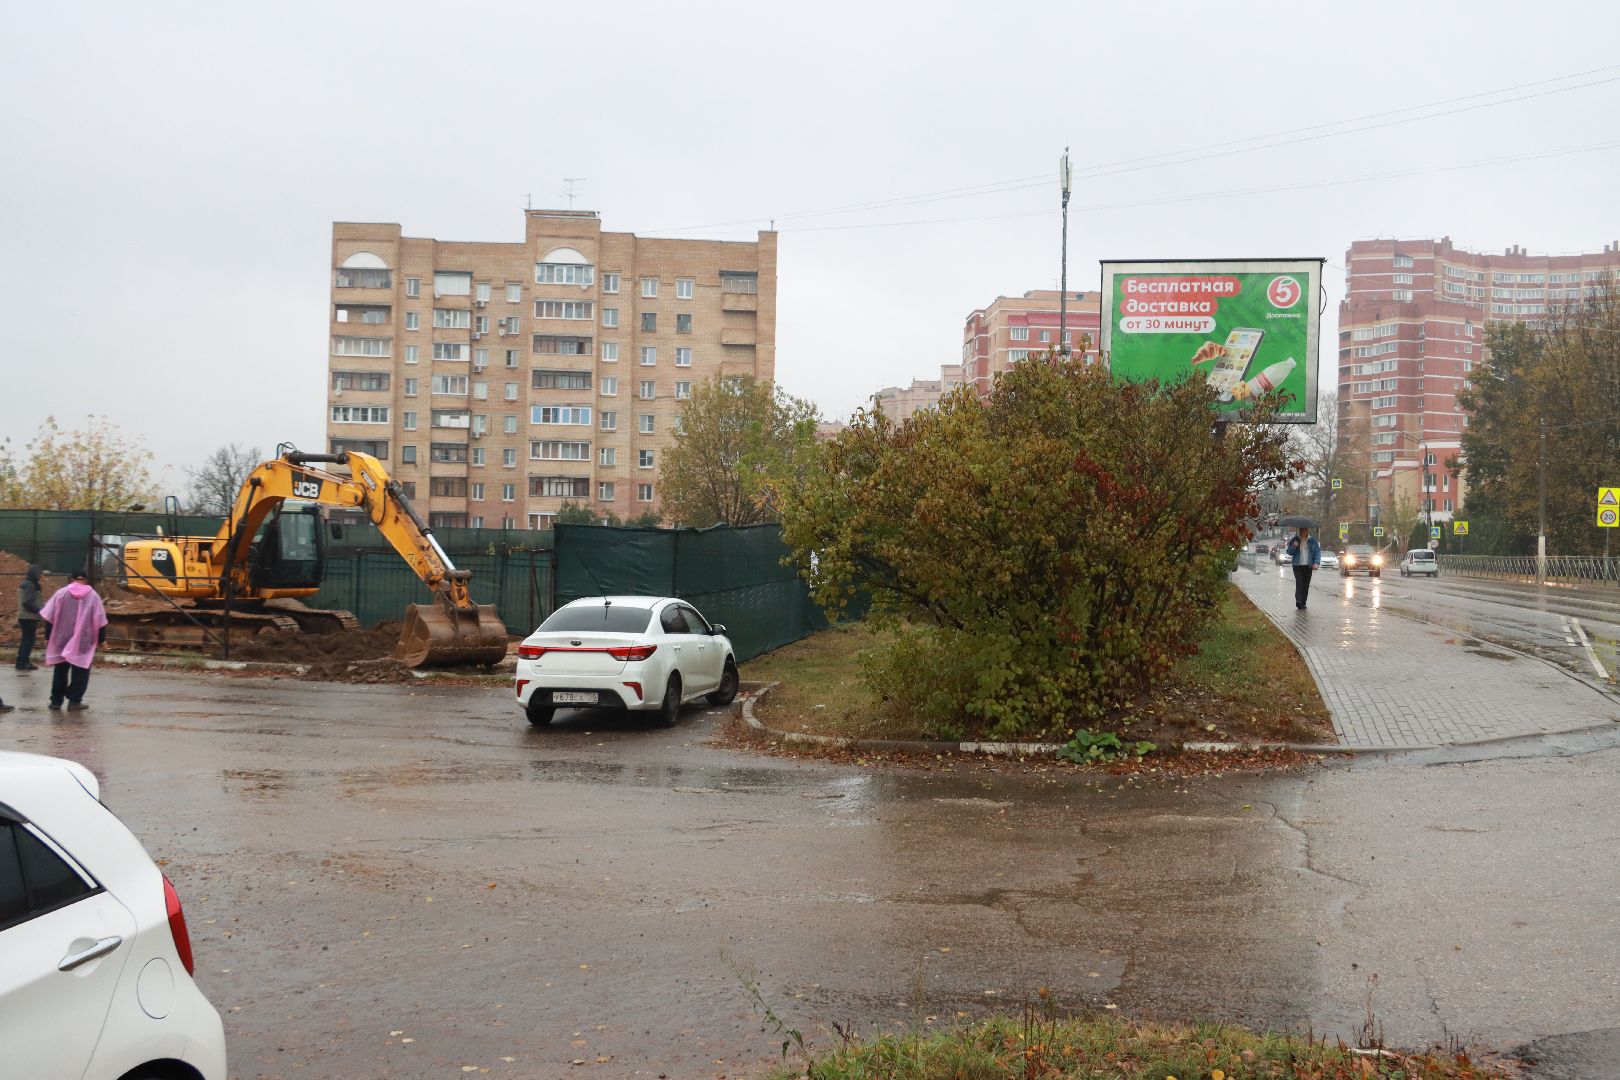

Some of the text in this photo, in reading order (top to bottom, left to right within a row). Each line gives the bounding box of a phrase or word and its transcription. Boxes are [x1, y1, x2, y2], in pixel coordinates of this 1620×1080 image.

[1127, 279, 1234, 293] Бесплатная
[1275, 278, 1295, 302] 5
[1126, 298, 1211, 313] доставка
[1126, 319, 1210, 331] от 30 минут
[294, 481, 319, 498] JCB
[1603, 513, 1614, 521] 20
[151, 549, 168, 561] JCB
